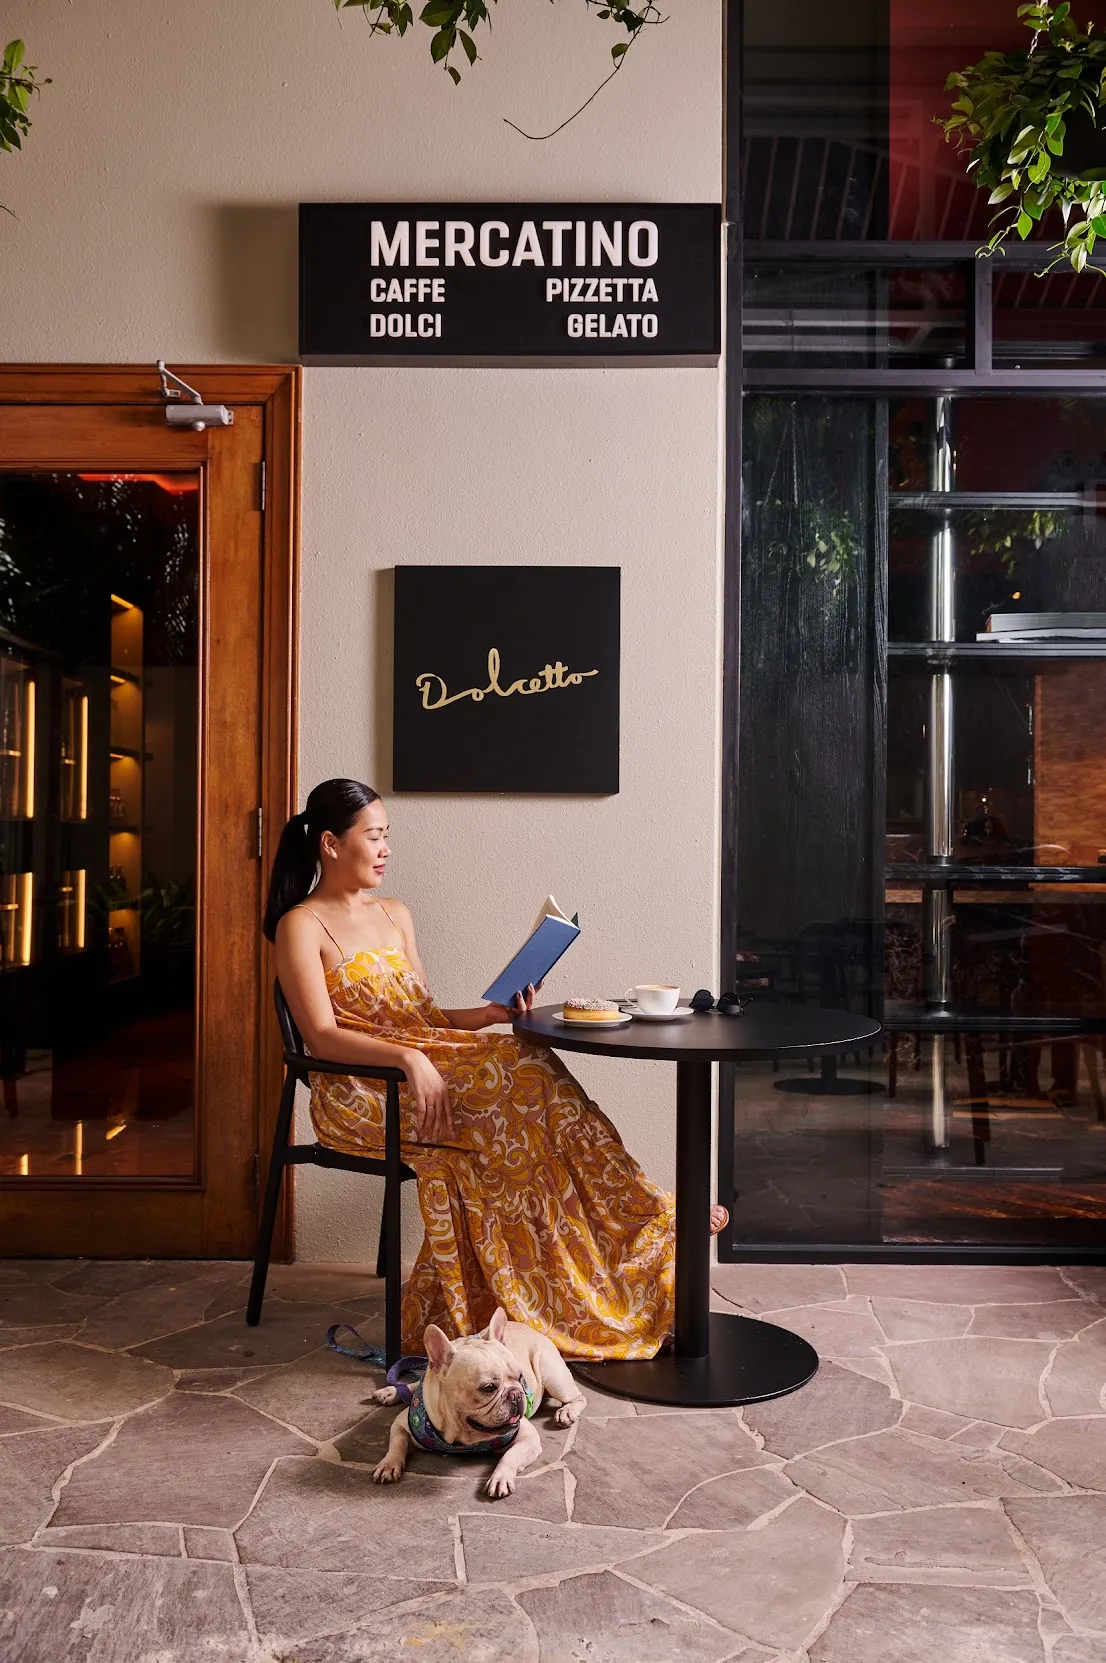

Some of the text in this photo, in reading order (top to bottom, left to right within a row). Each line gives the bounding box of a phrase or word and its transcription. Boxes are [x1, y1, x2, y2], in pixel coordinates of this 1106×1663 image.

[370, 220, 659, 267] MERCATINO
[370, 278, 446, 303] CAFFE
[546, 278, 659, 303] PIZZETTA
[370, 313, 442, 338] DOLCI
[567, 313, 659, 338] GELATO
[415, 647, 599, 710] Dolcetto
